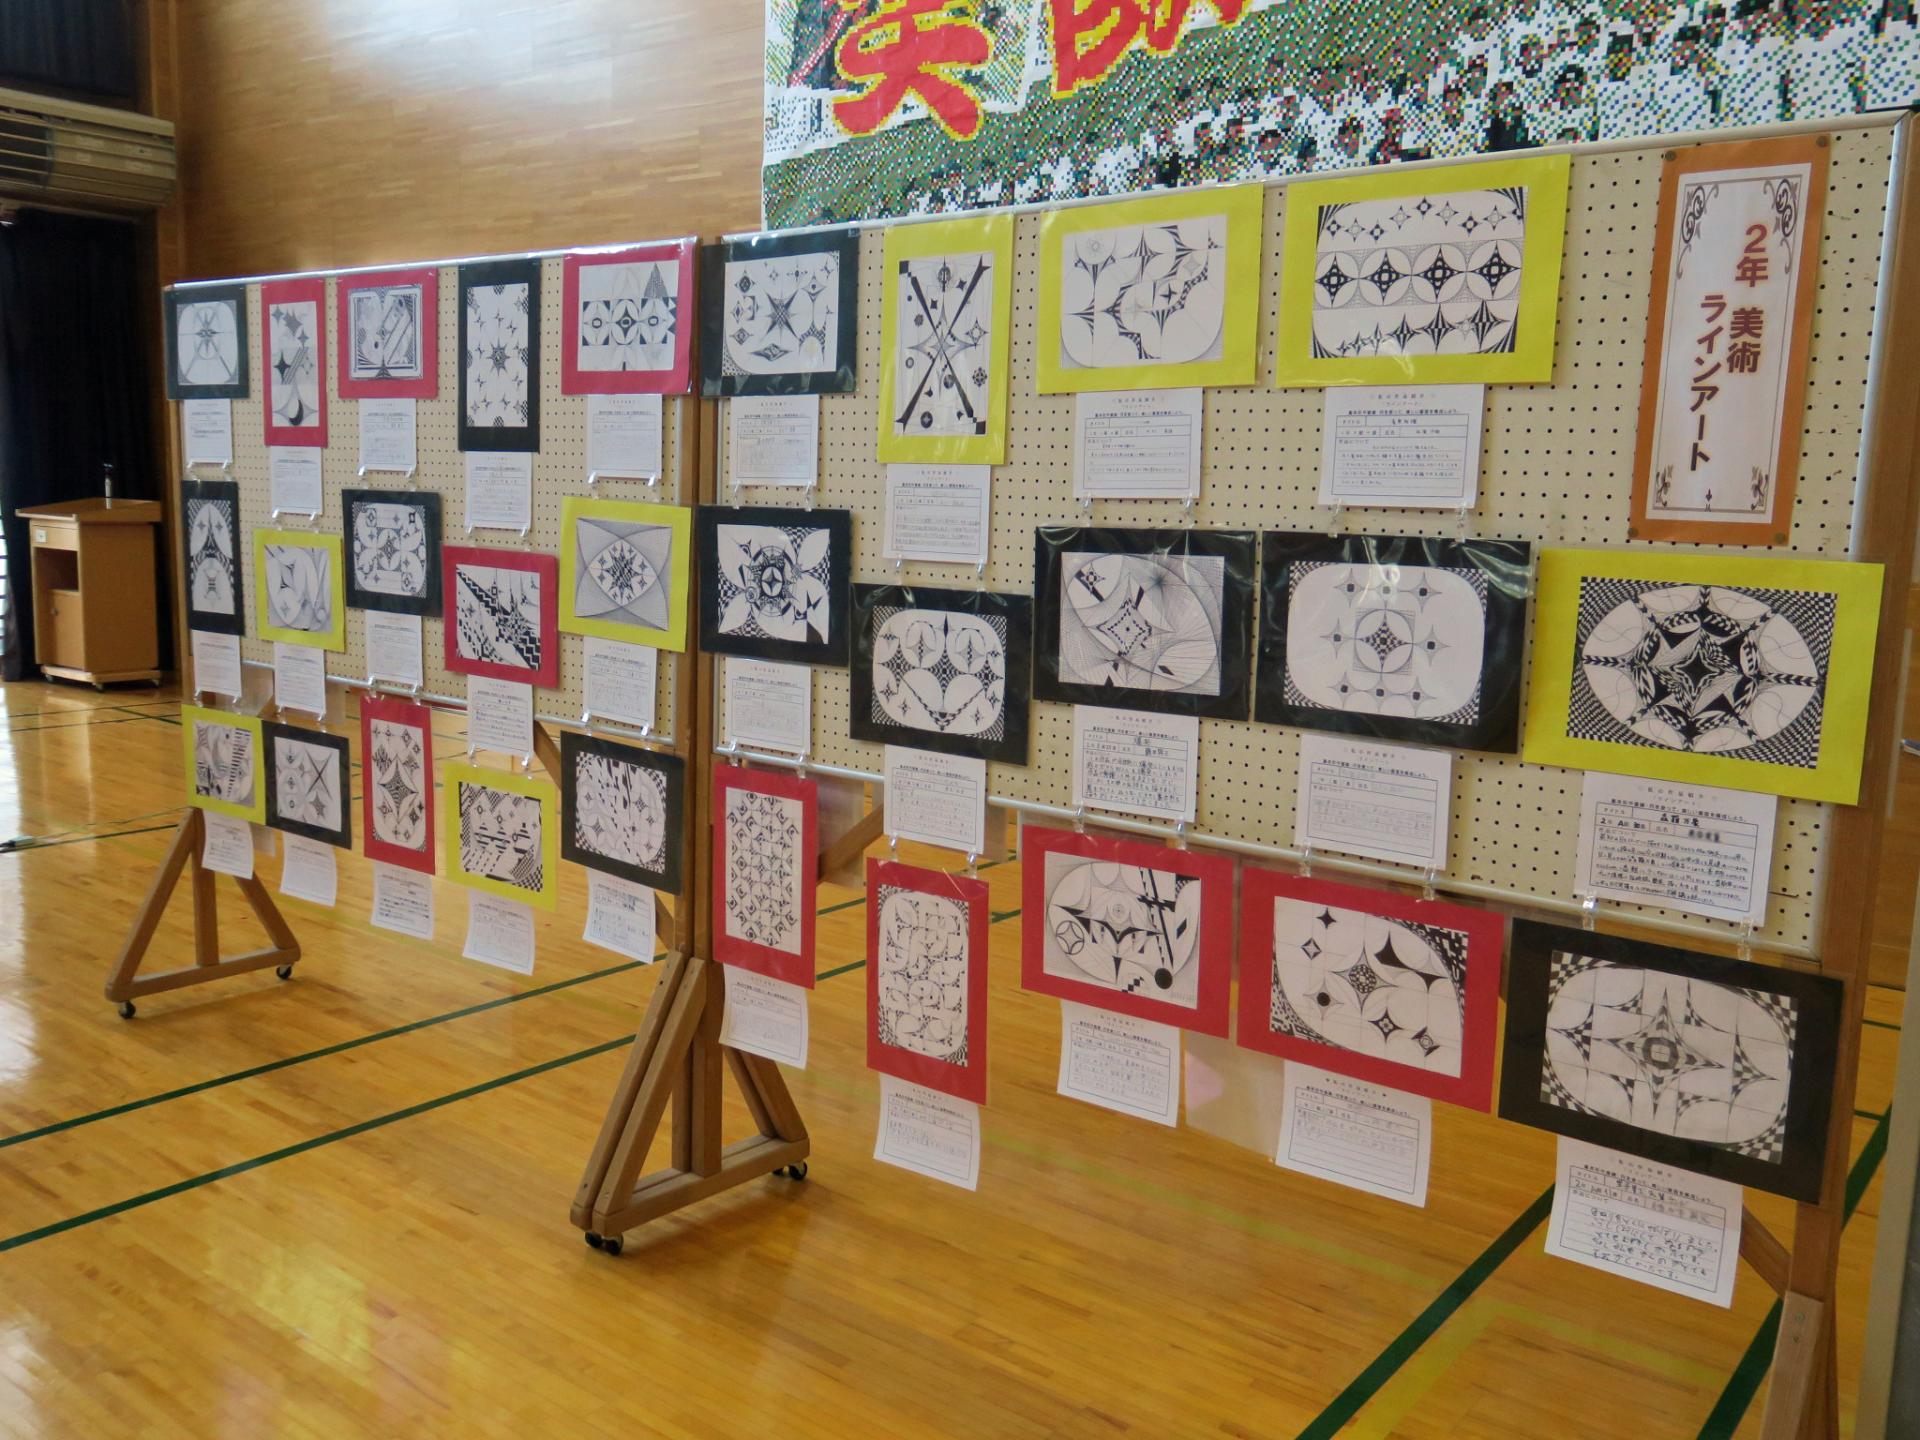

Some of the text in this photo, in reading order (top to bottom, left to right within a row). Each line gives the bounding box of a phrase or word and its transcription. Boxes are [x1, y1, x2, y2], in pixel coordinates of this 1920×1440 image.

[1727, 224, 1769, 374] 2年 美術
[1690, 293, 1727, 472] ラインアート
